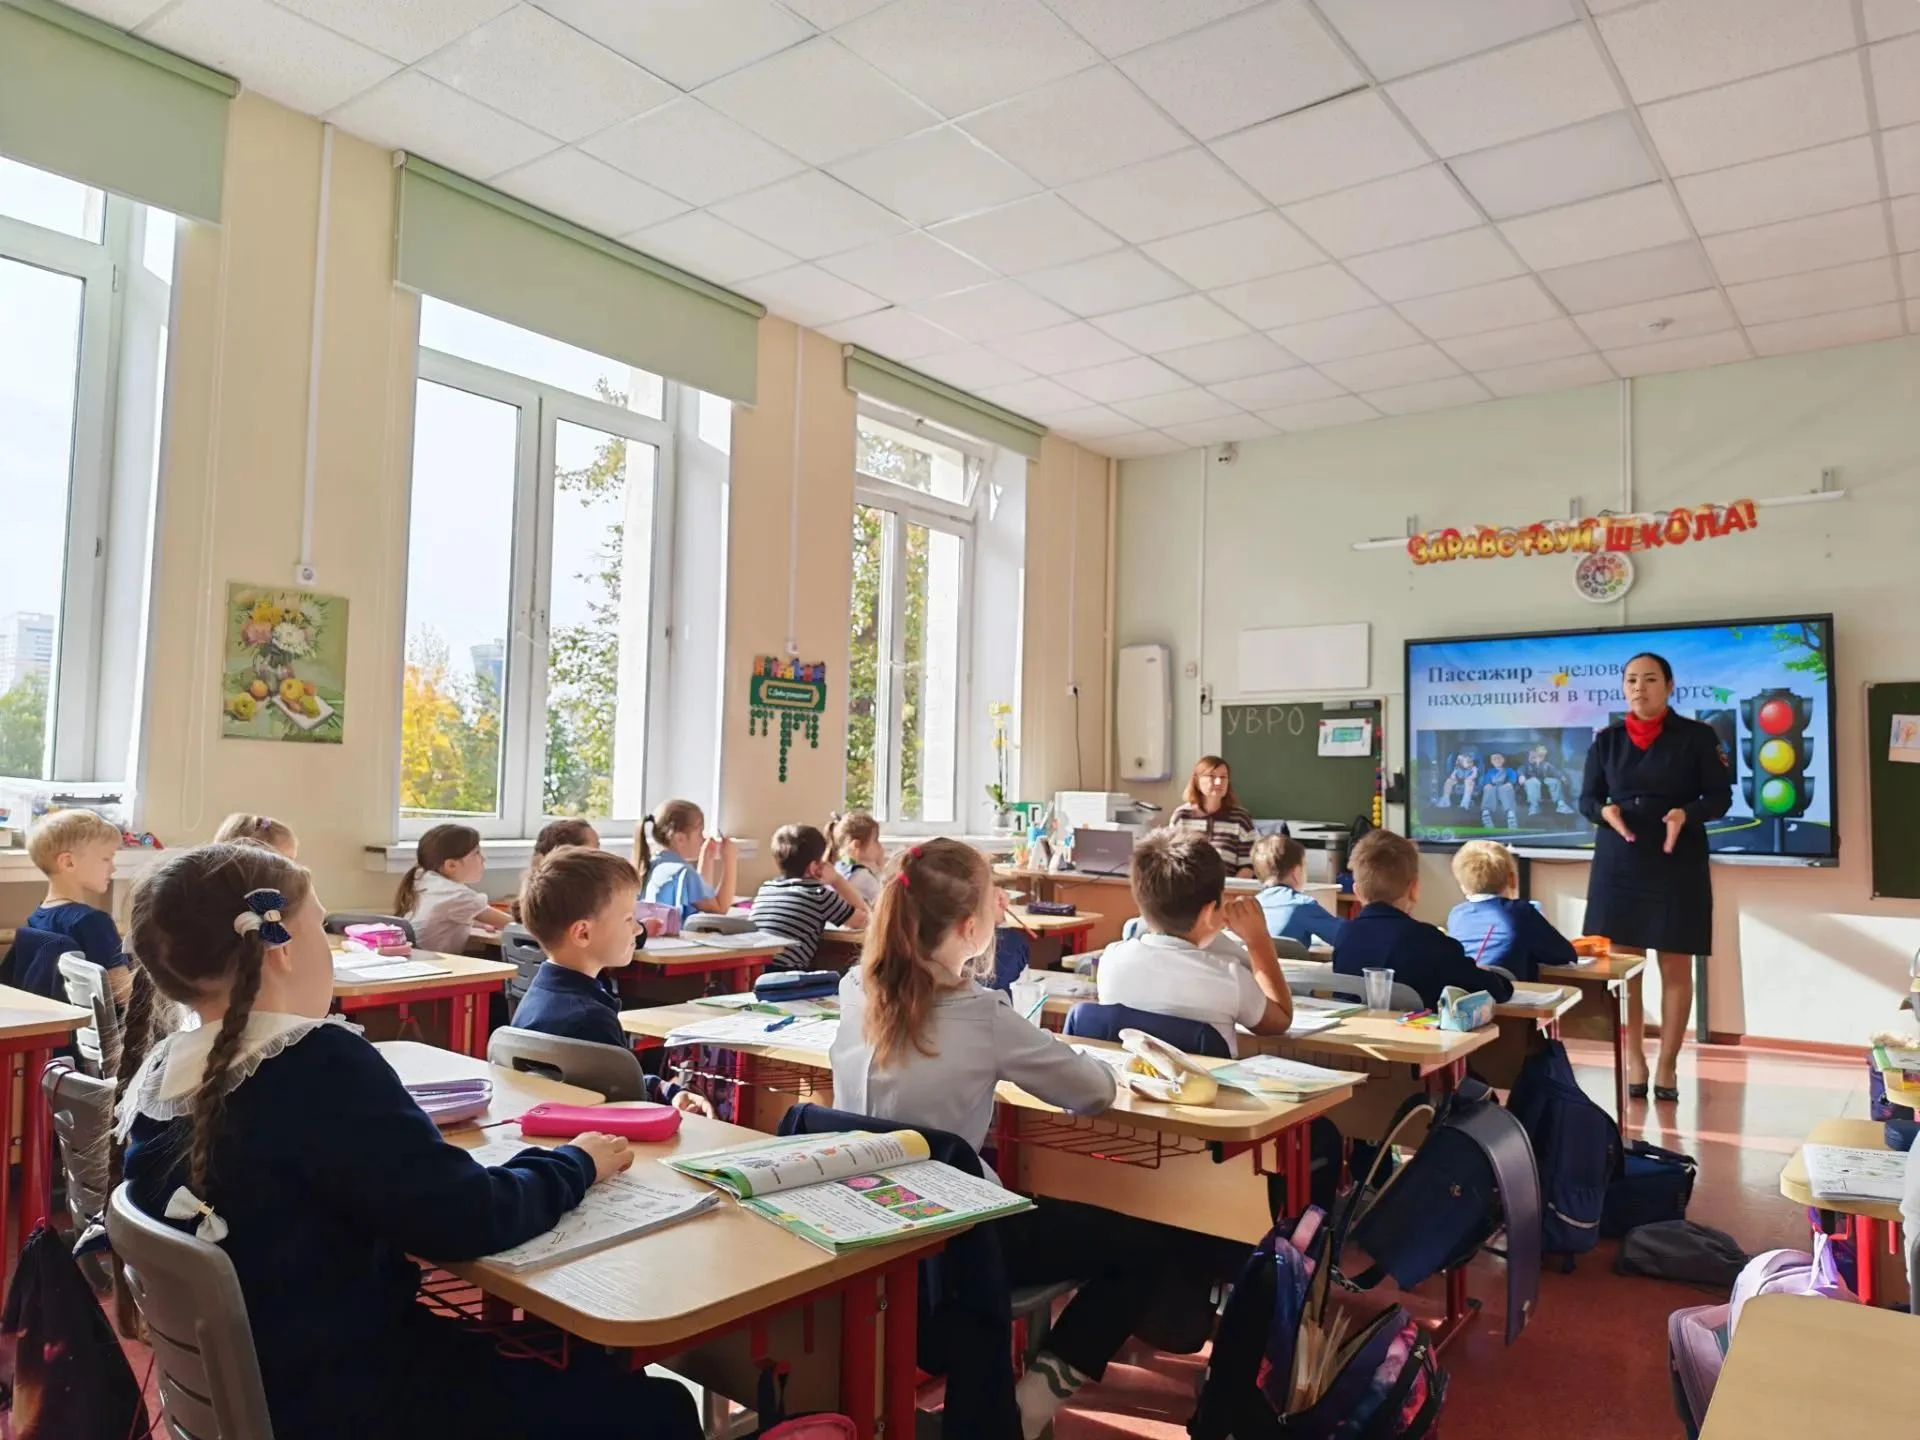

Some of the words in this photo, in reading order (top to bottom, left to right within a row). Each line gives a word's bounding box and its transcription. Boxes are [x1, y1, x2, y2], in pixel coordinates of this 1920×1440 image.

[1606, 503, 1757, 552] ШКОЛА!
[1428, 666, 1533, 684] Пассажир
[1428, 687, 1560, 707] находящийся
[1567, 690, 1578, 702] в
